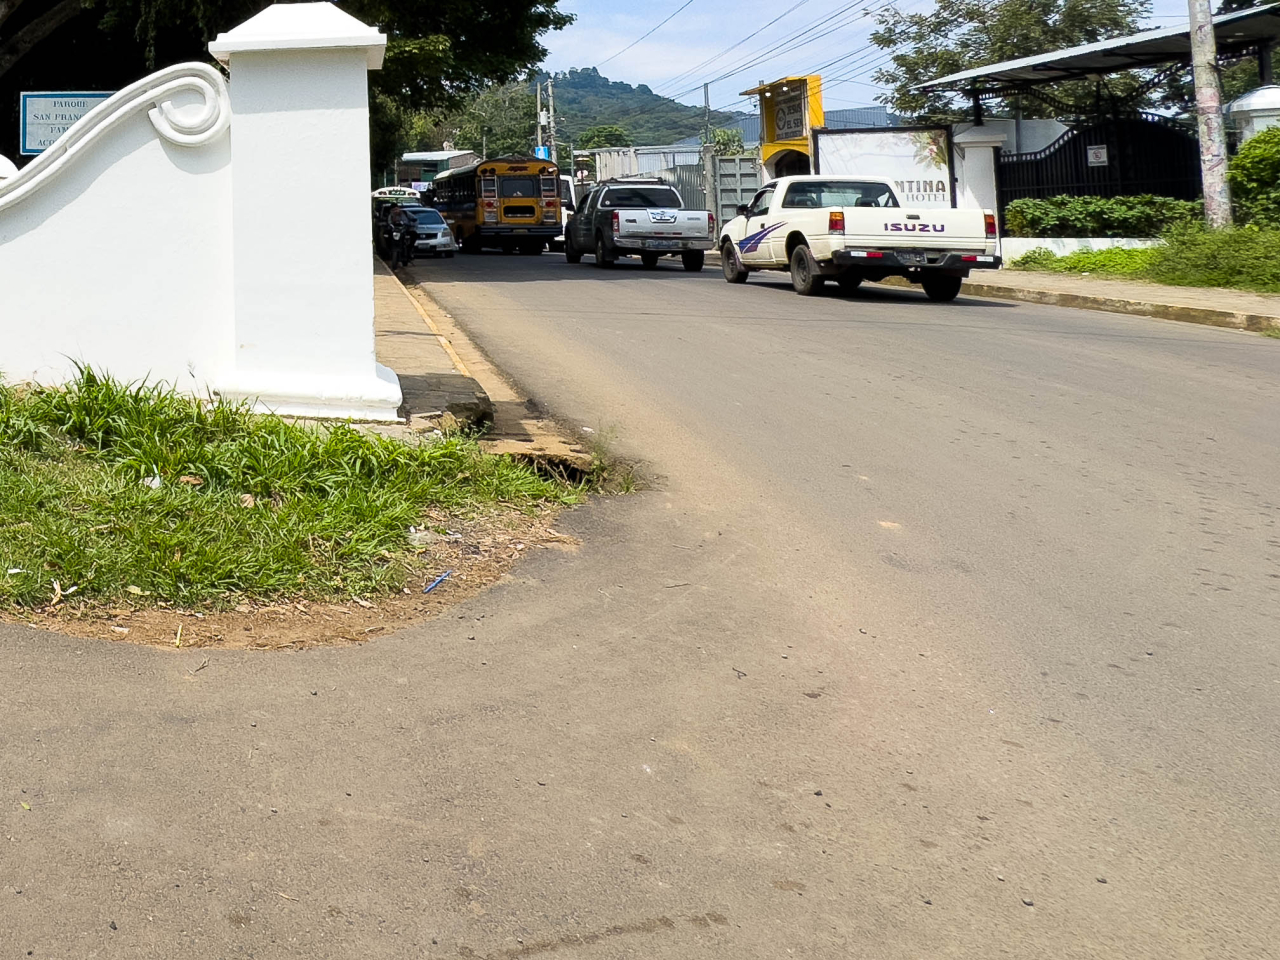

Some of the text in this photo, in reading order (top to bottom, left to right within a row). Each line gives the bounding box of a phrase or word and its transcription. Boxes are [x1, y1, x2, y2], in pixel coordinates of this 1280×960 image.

[53, 100, 89, 108] PARQUE
[33, 113, 51, 121] SAN
[907, 193, 949, 202] HOTEL
[884, 223, 945, 233] ISUZU
